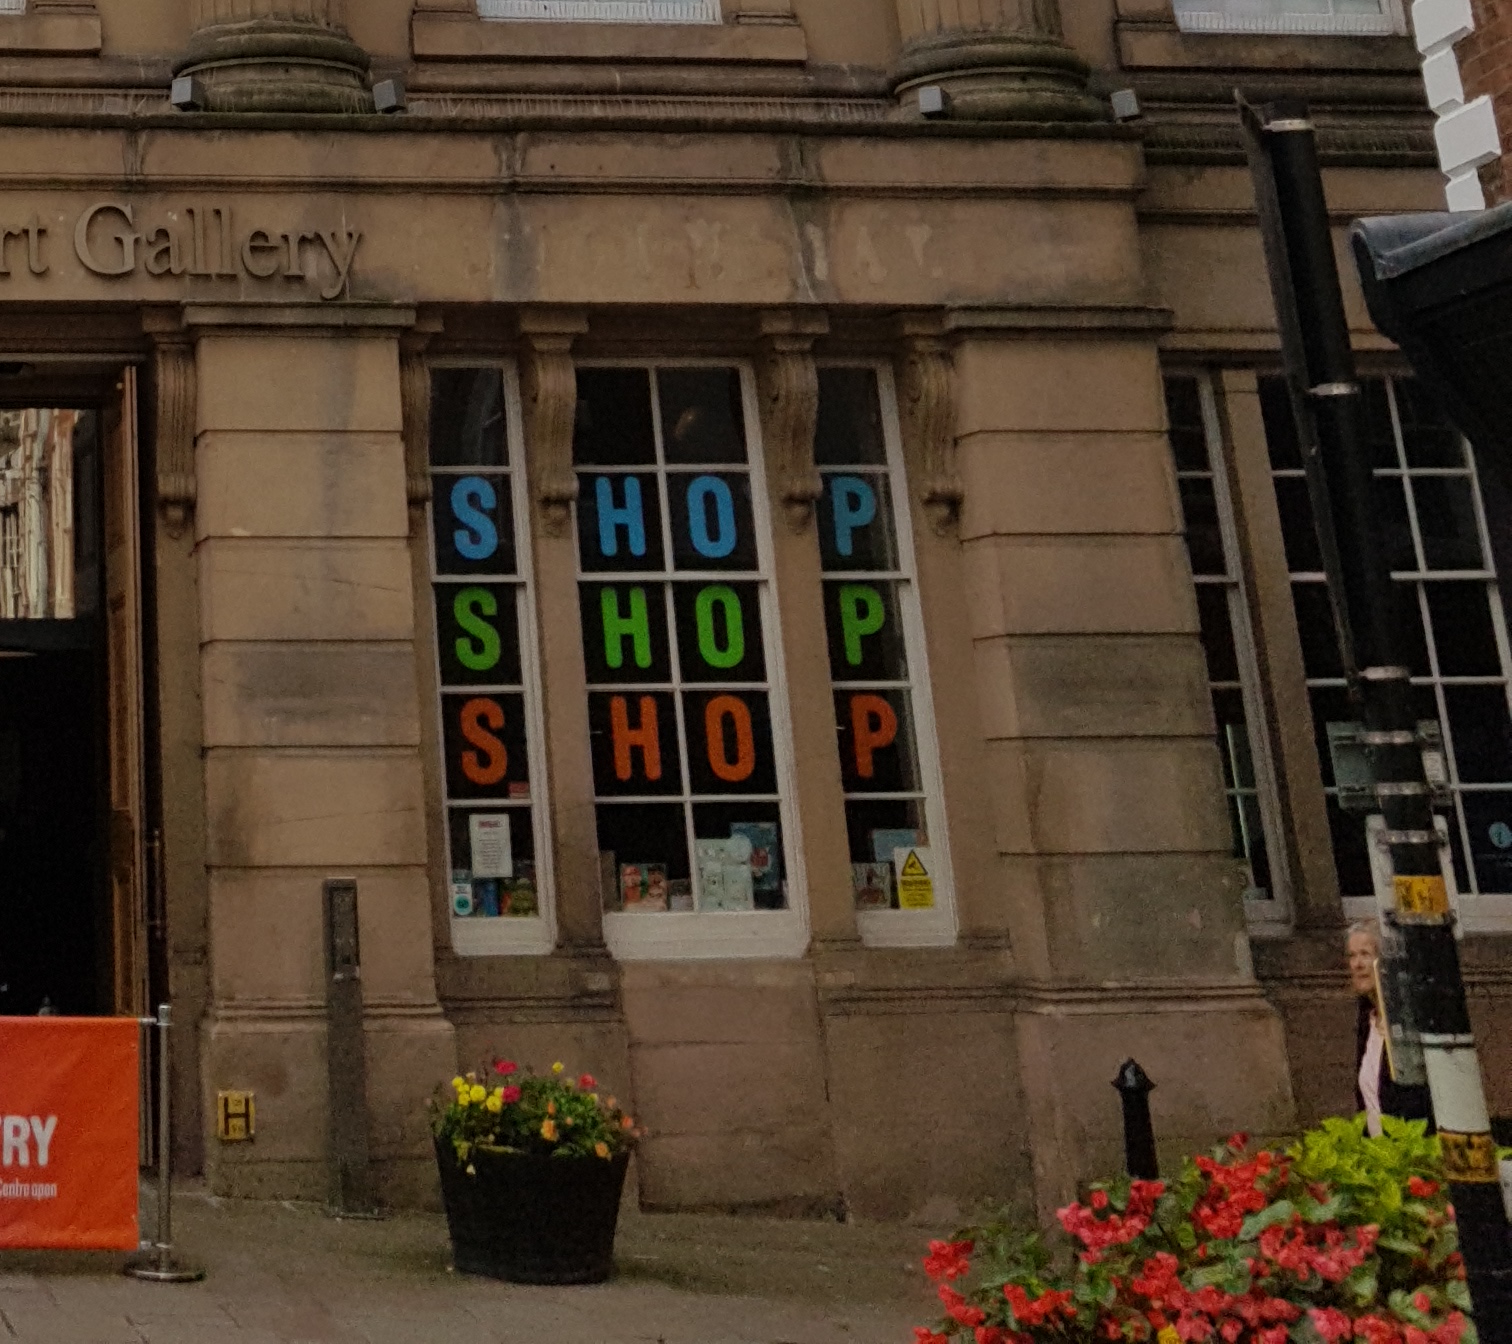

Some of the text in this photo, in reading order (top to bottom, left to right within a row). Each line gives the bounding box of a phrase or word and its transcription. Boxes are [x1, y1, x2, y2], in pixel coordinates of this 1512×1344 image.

[72, 201, 364, 300] Gallery
[450, 474, 877, 560] SHOP
[454, 585, 886, 671] SHOP
[460, 694, 899, 785] SHOP
[31, 1183, 58, 1201] open
